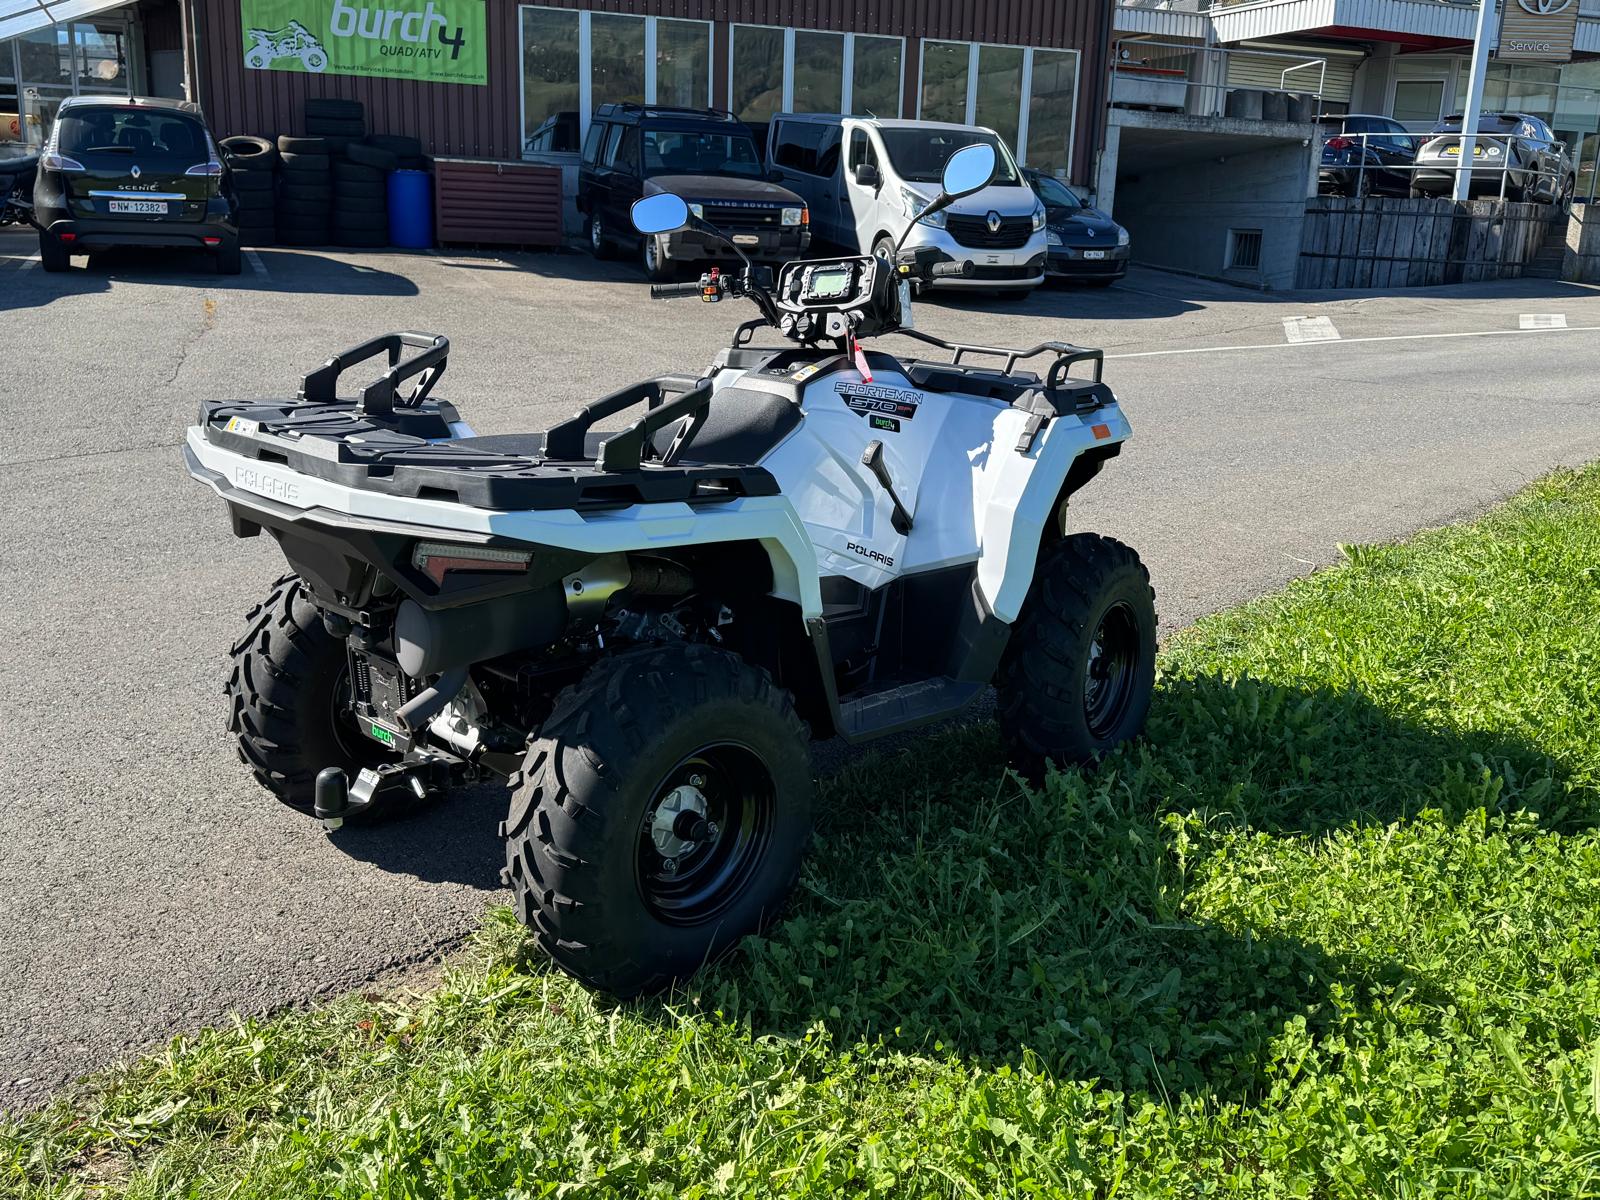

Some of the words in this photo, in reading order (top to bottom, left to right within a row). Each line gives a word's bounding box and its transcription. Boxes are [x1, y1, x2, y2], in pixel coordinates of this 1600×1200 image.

[379, 45, 441, 59] QUAD/ATV
[1510, 41, 1550, 51] Service
[118, 203, 129, 211] NW
[135, 203, 160, 212] 12382
[834, 382, 924, 404] SPORTSMAN
[849, 396, 897, 412] 570
[236, 466, 299, 499] POLARIS
[846, 542, 894, 567] POLARIS
